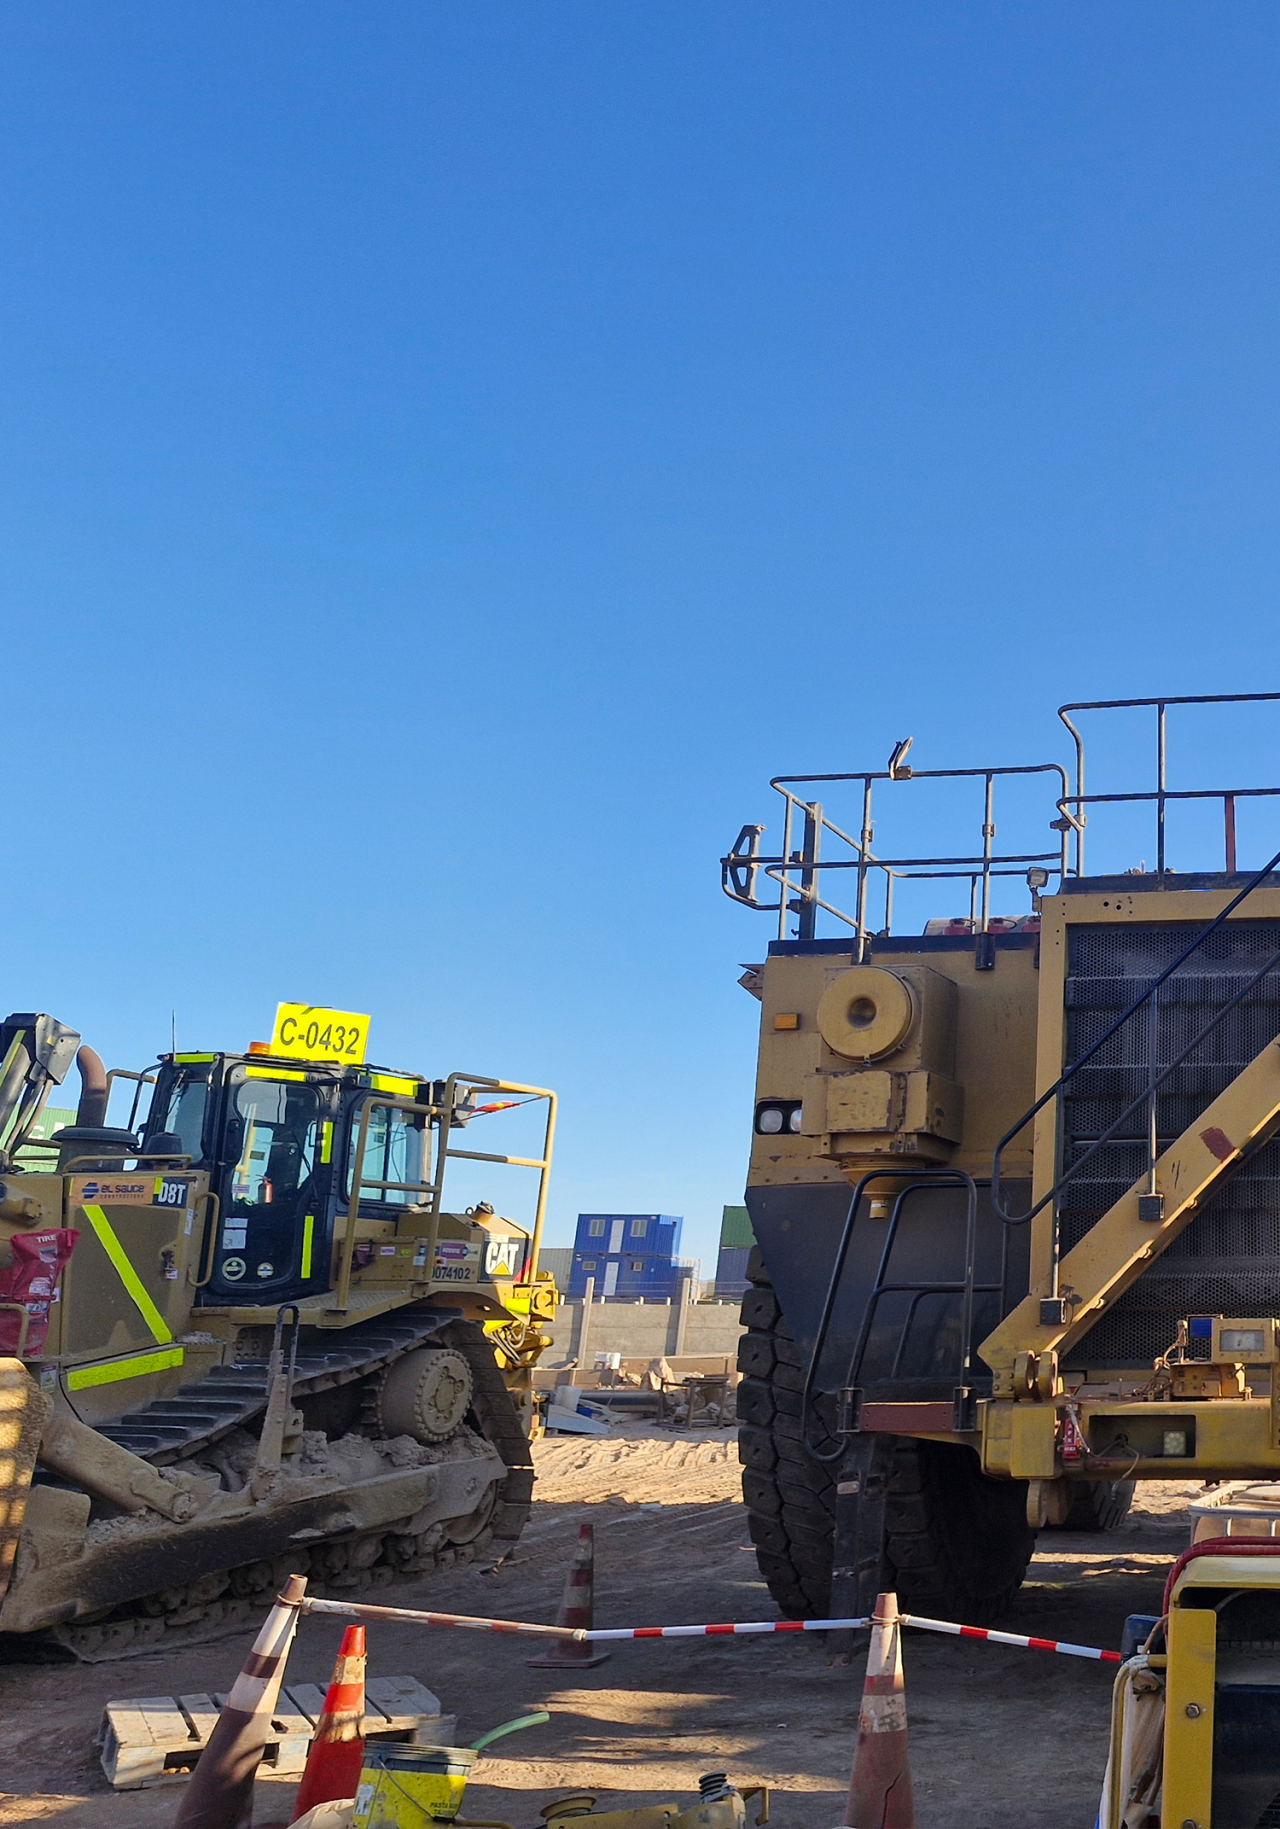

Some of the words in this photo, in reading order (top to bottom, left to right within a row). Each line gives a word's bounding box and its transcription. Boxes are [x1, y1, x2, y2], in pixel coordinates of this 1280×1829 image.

[280, 1017, 360, 1055] C-0432
[158, 1182, 186, 1205] D8T
[485, 1242, 519, 1276] CAT
